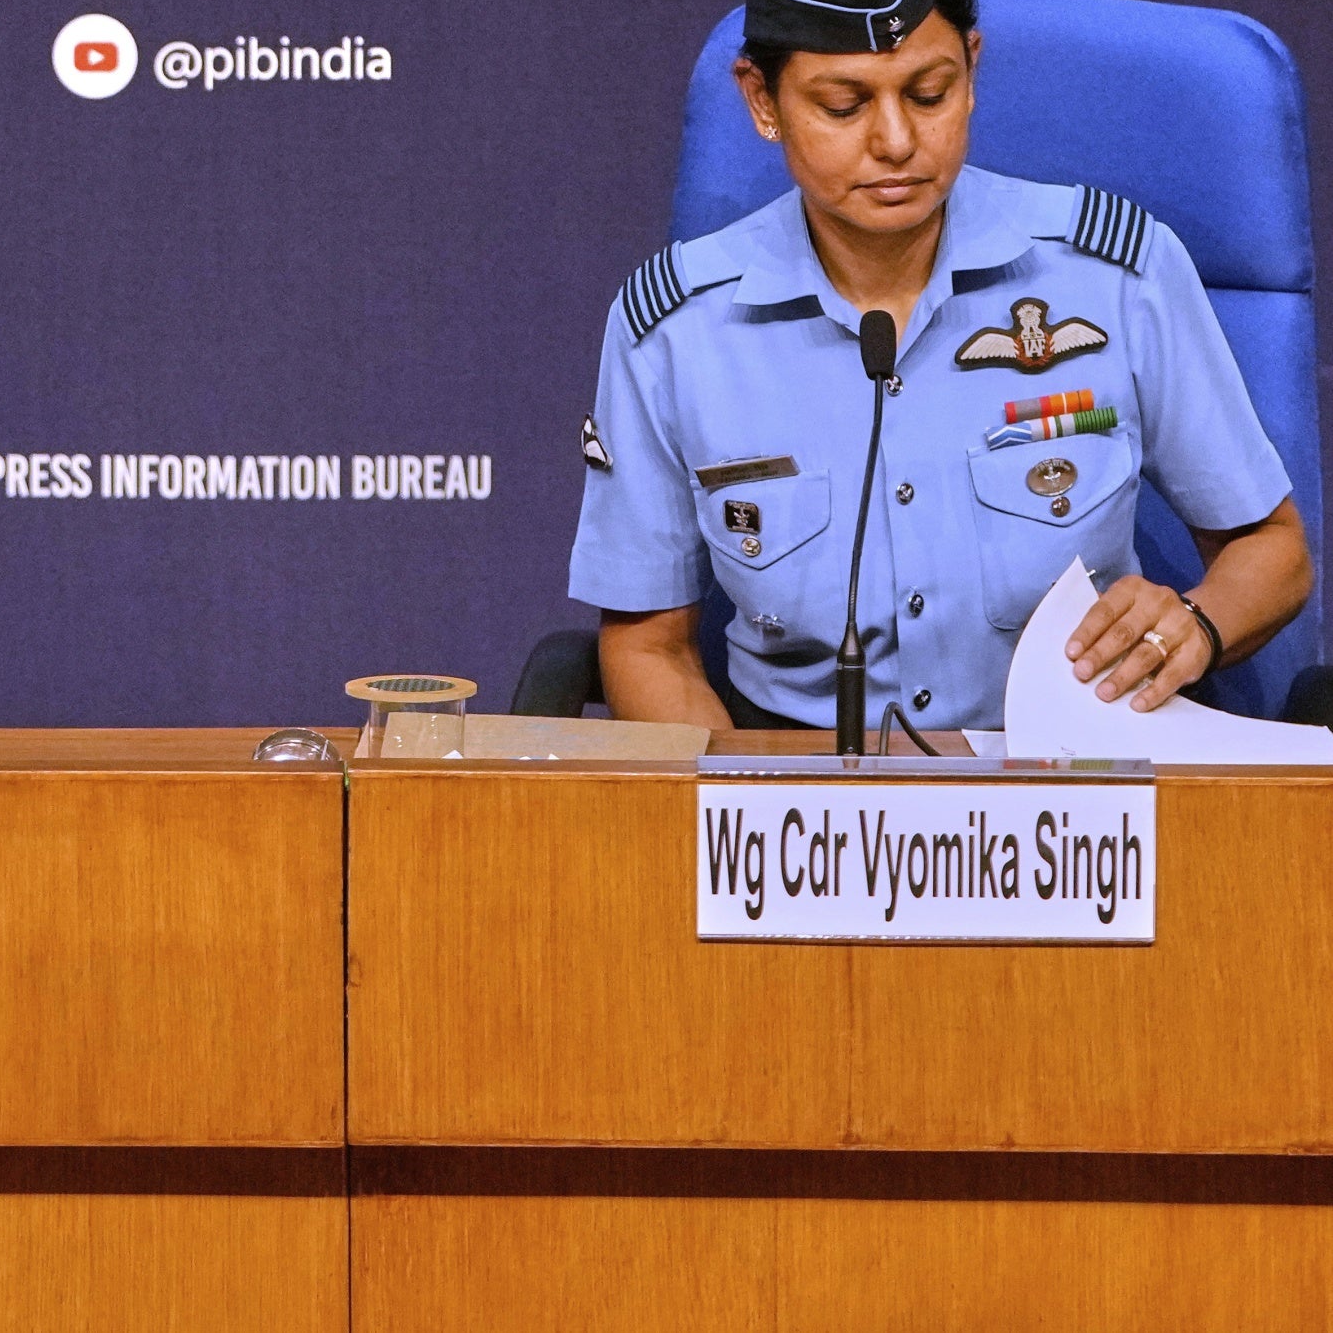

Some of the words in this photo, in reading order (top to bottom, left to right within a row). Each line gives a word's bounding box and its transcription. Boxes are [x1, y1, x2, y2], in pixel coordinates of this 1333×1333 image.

[153, 35, 393, 92] @pibindia
[1022, 338, 1046, 358] IAF
[101, 454, 342, 501] INFORMATION
[351, 454, 493, 501] BUREAU
[705, 807, 766, 921] Wg
[780, 807, 848, 898] Cdr
[859, 809, 1021, 923] Vyomika
[1034, 810, 1143, 925] Singh
